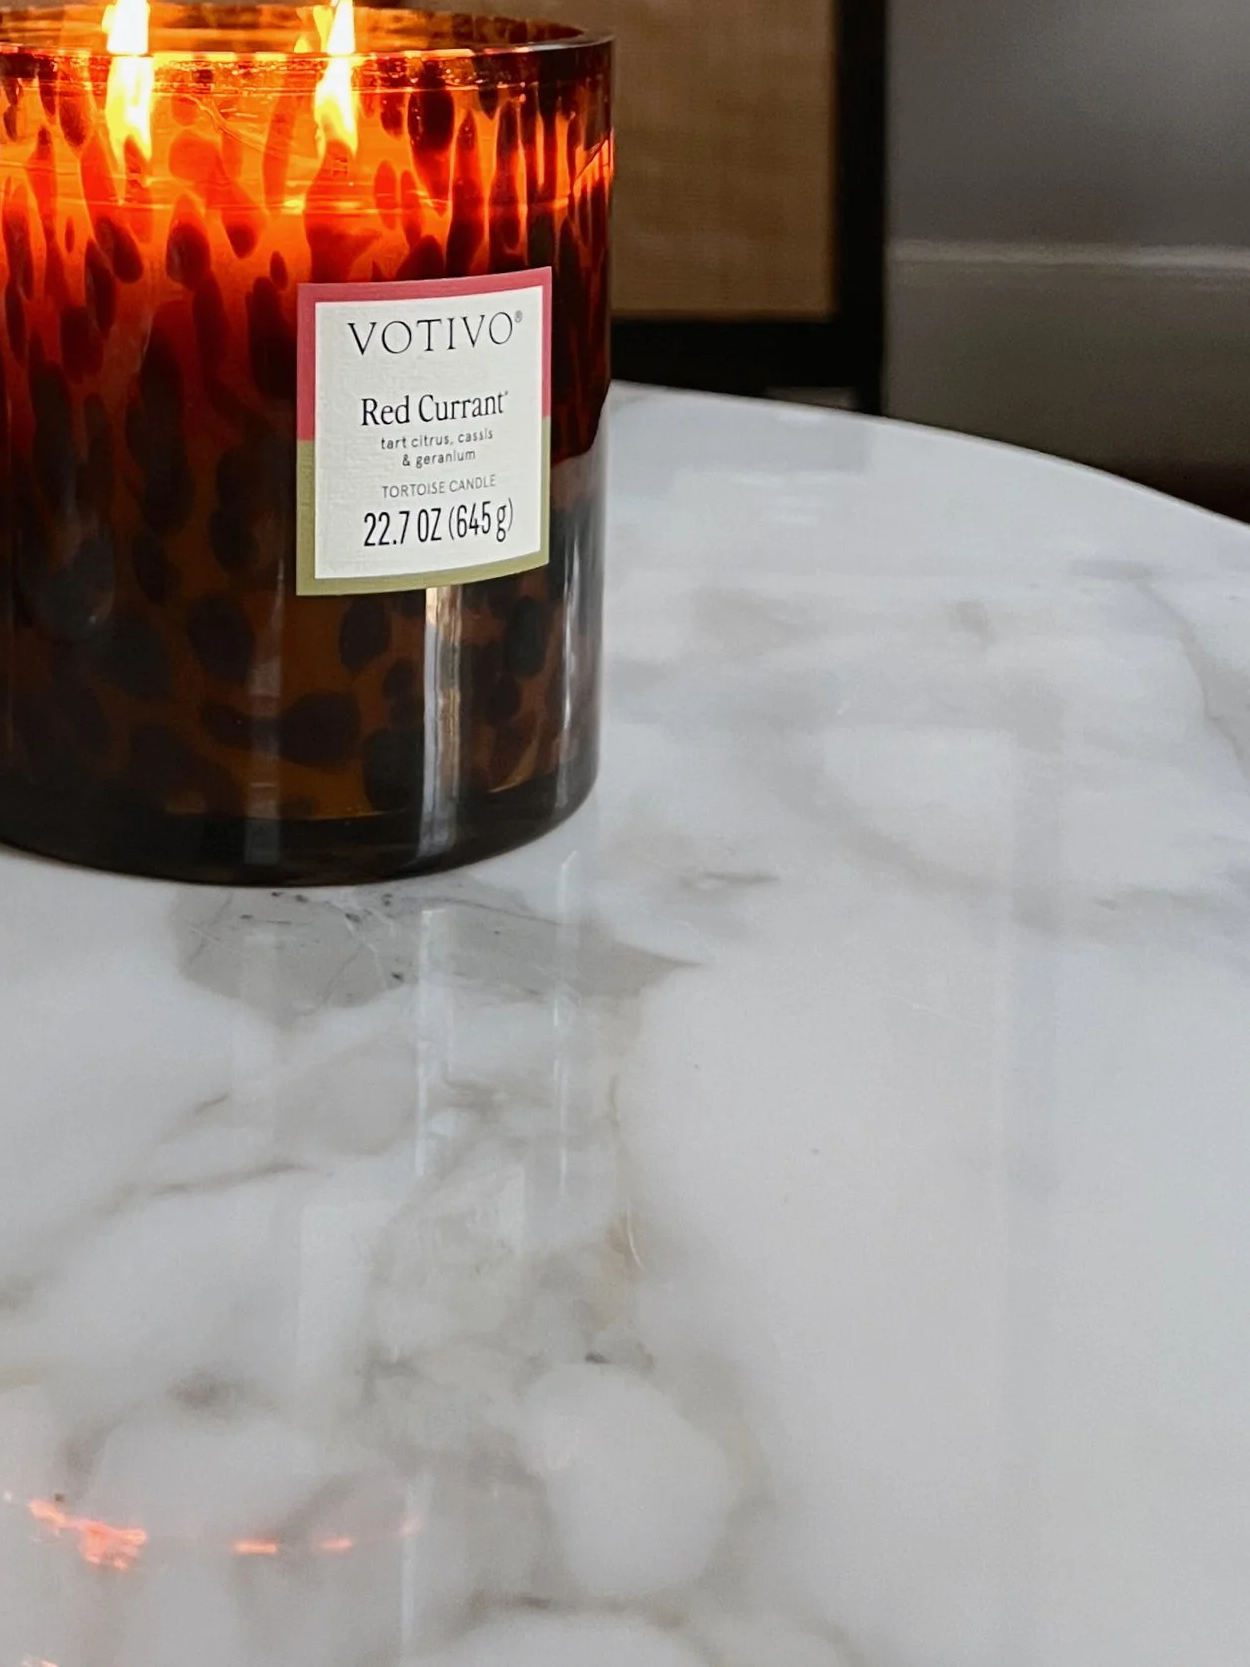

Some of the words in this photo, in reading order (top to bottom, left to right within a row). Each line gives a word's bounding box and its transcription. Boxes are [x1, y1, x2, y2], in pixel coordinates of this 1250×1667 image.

[361, 394, 411, 426] Red
[380, 436, 407, 450] tart
[411, 434, 454, 448] citrus,
[457, 428, 494, 444] cassis
[401, 453, 411, 467] &
[415, 449, 476, 469] geranium
[382, 481, 445, 499] TORTOISE
[449, 474, 496, 493] CANDLE
[363, 510, 411, 547] 22.7
[417, 507, 442, 543] OZ
